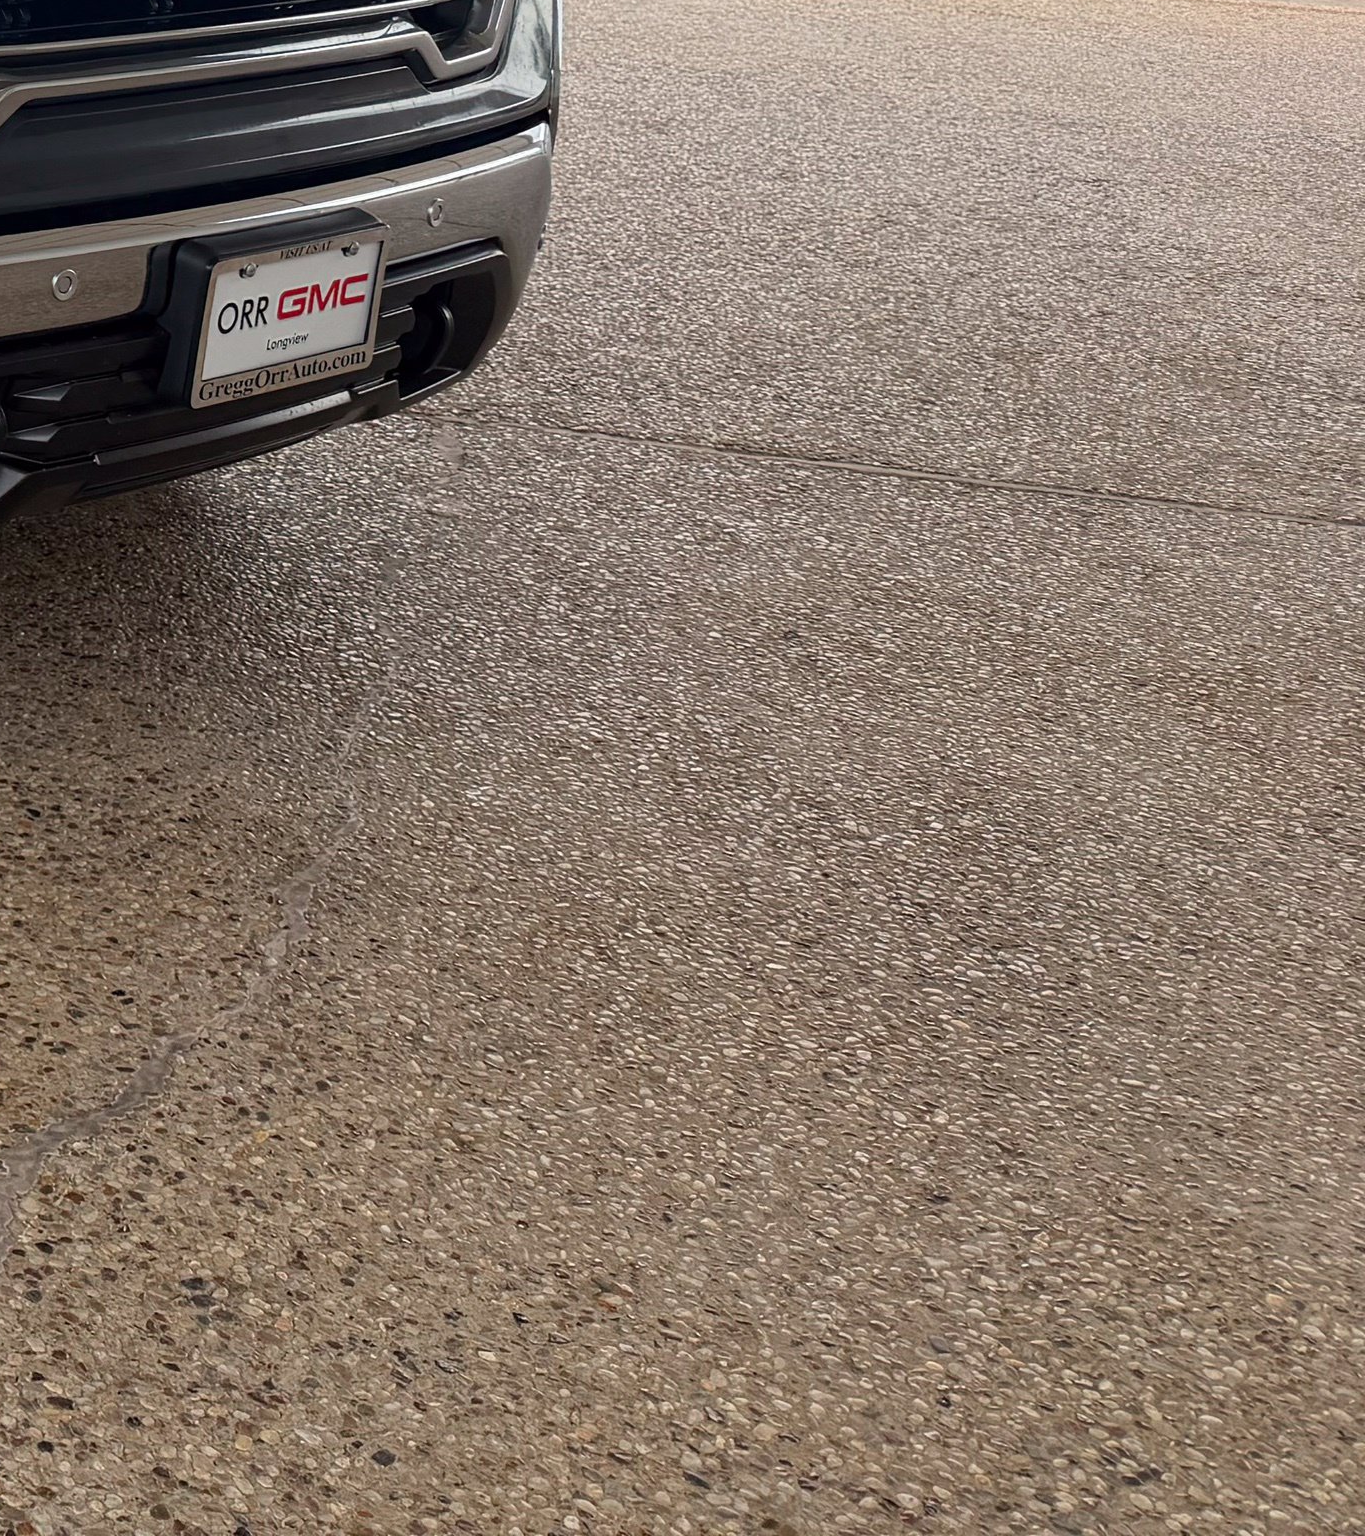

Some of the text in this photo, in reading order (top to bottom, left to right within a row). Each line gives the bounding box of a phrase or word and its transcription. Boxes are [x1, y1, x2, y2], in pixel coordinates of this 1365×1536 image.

[217, 272, 370, 335] ORR GMC
[265, 331, 310, 351] Longview
[198, 350, 367, 401] GreggOrrAuto.com
